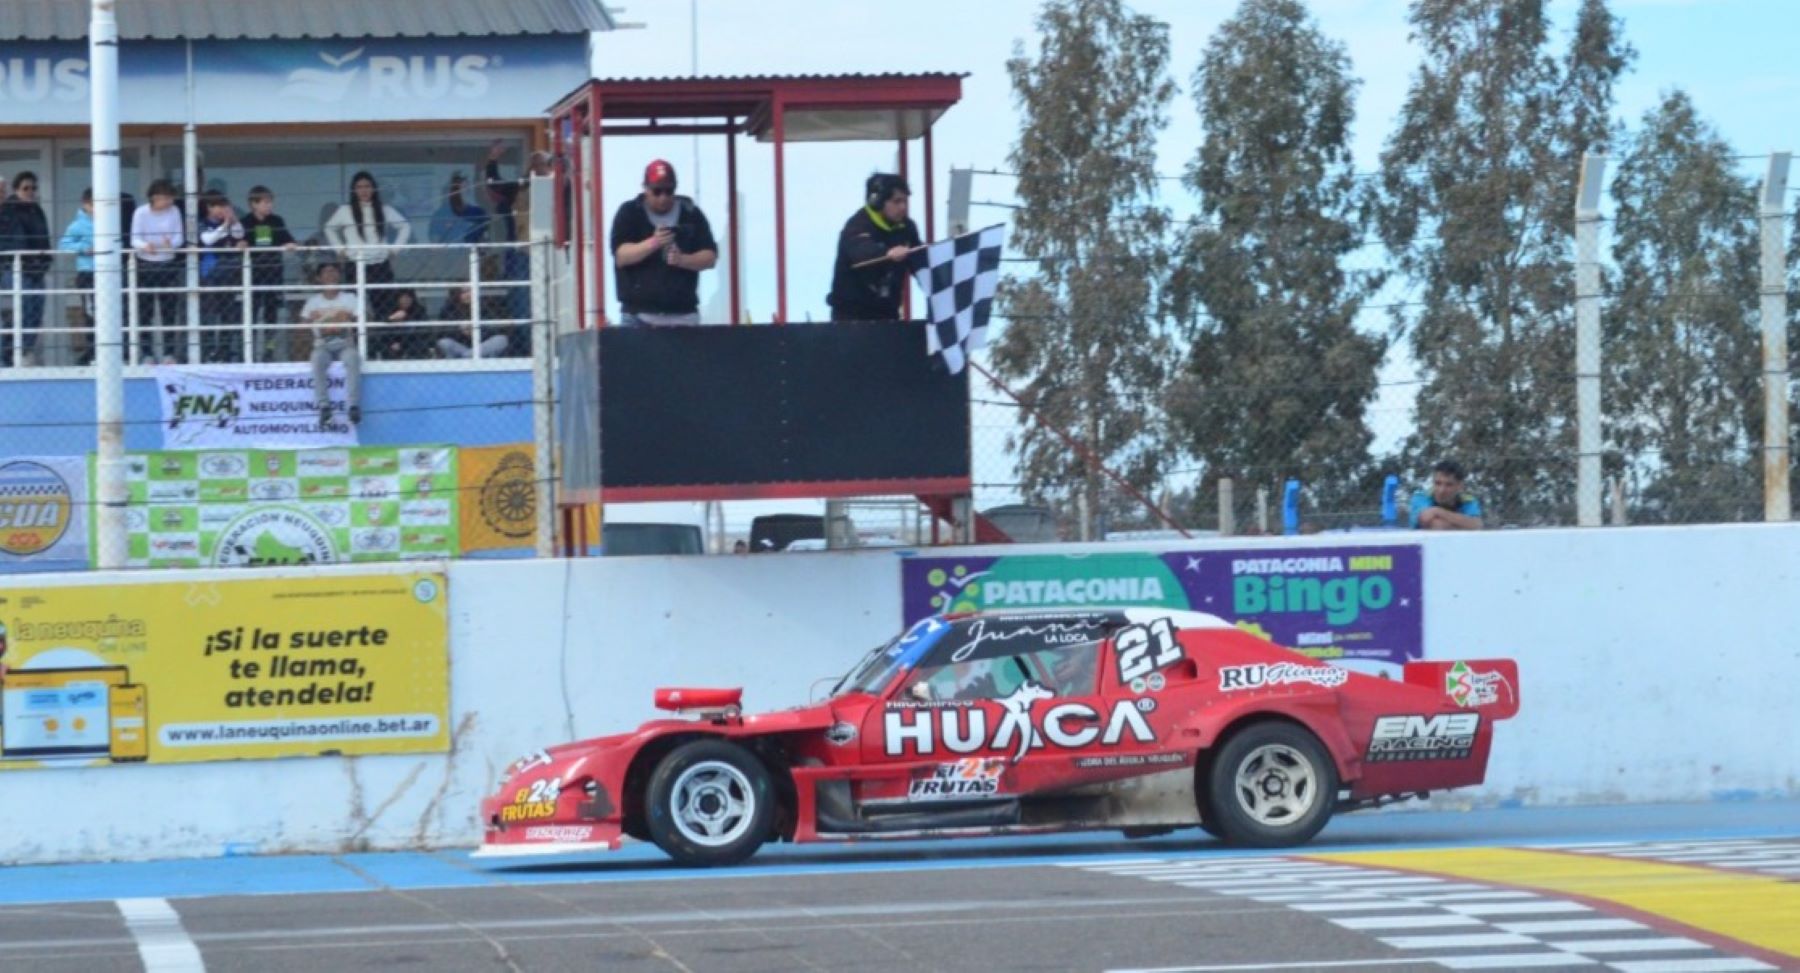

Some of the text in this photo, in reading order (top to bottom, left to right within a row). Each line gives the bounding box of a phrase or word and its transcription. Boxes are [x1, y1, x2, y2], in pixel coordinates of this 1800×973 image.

[0, 57, 88, 101] US
[174, 395, 234, 416] FNA
[1232, 556, 1344, 574] PATAGONIA
[983, 576, 1163, 605] PATAGONIA
[1234, 574, 1393, 625] Bingo
[204, 625, 389, 657] ¡Si la suerte
[1116, 617, 1182, 683] 21
[230, 655, 366, 679] te llama,
[223, 681, 375, 708] atendela!
[167, 718, 432, 742] www.laneuquinaonline.bet.ar
[884, 698, 1156, 760] HUACA
[1369, 737, 1474, 753] RACING
[527, 777, 561, 802] 24
[910, 779, 997, 795] FRUTAS
[501, 801, 556, 821] FRUTAS
